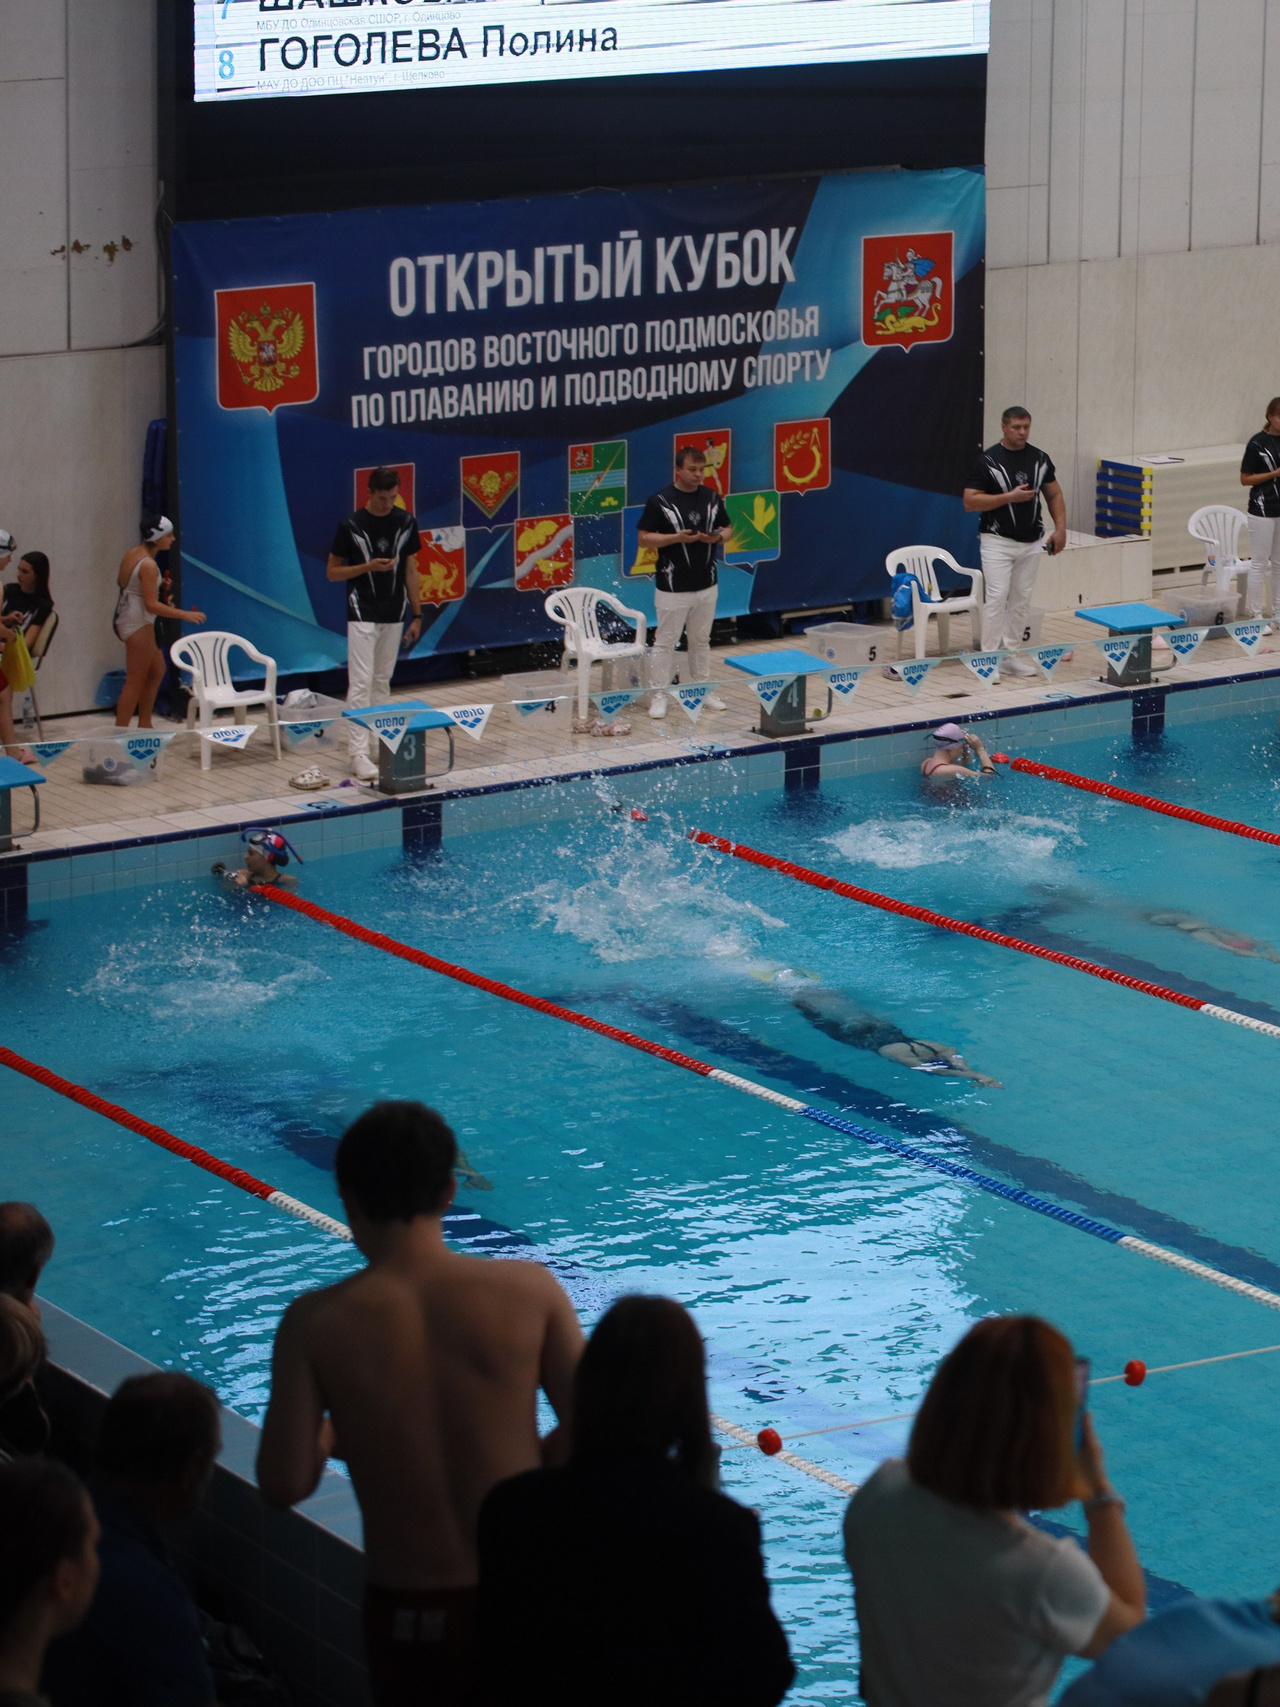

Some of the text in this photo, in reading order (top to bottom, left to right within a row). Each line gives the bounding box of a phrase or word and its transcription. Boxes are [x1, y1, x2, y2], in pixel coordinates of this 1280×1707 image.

[282, 18, 298, 30] ДО
[412, 11, 461, 22] Одинцово
[259, 24, 618, 71] ГОГОЛЕВА Полина
[218, 49, 235, 79] 8
[389, 226, 796, 317] ОТКРЫТЫЙ КУБОК
[363, 305, 819, 380] ГОРОДОВ ВОСТОЧНОГО ПОДМОСКОВЬЯ
[351, 348, 832, 429] ПО ПЛАВАНИЮ И ПОДВОДНОМУ СПОРТУ
[1215, 611, 1224, 625] 6
[1022, 626, 1031, 641] 5
[1234, 624, 1260, 636] arena
[1170, 631, 1199, 644] arena
[1103, 640, 1130, 652] arena
[868, 646, 877, 661] 5
[1038, 648, 1065, 661] arena
[971, 655, 997, 668] arena
[902, 663, 930, 676] arena
[830, 671, 858, 684] arena
[757, 679, 785, 692] arena
[679, 687, 706, 699] arena
[601, 694, 630, 706] arena
[452, 706, 486, 720] arena
[374, 716, 405, 729] arena
[212, 727, 247, 740] arena
[128, 738, 161, 749] arena
[403, 734, 416, 761] 3
